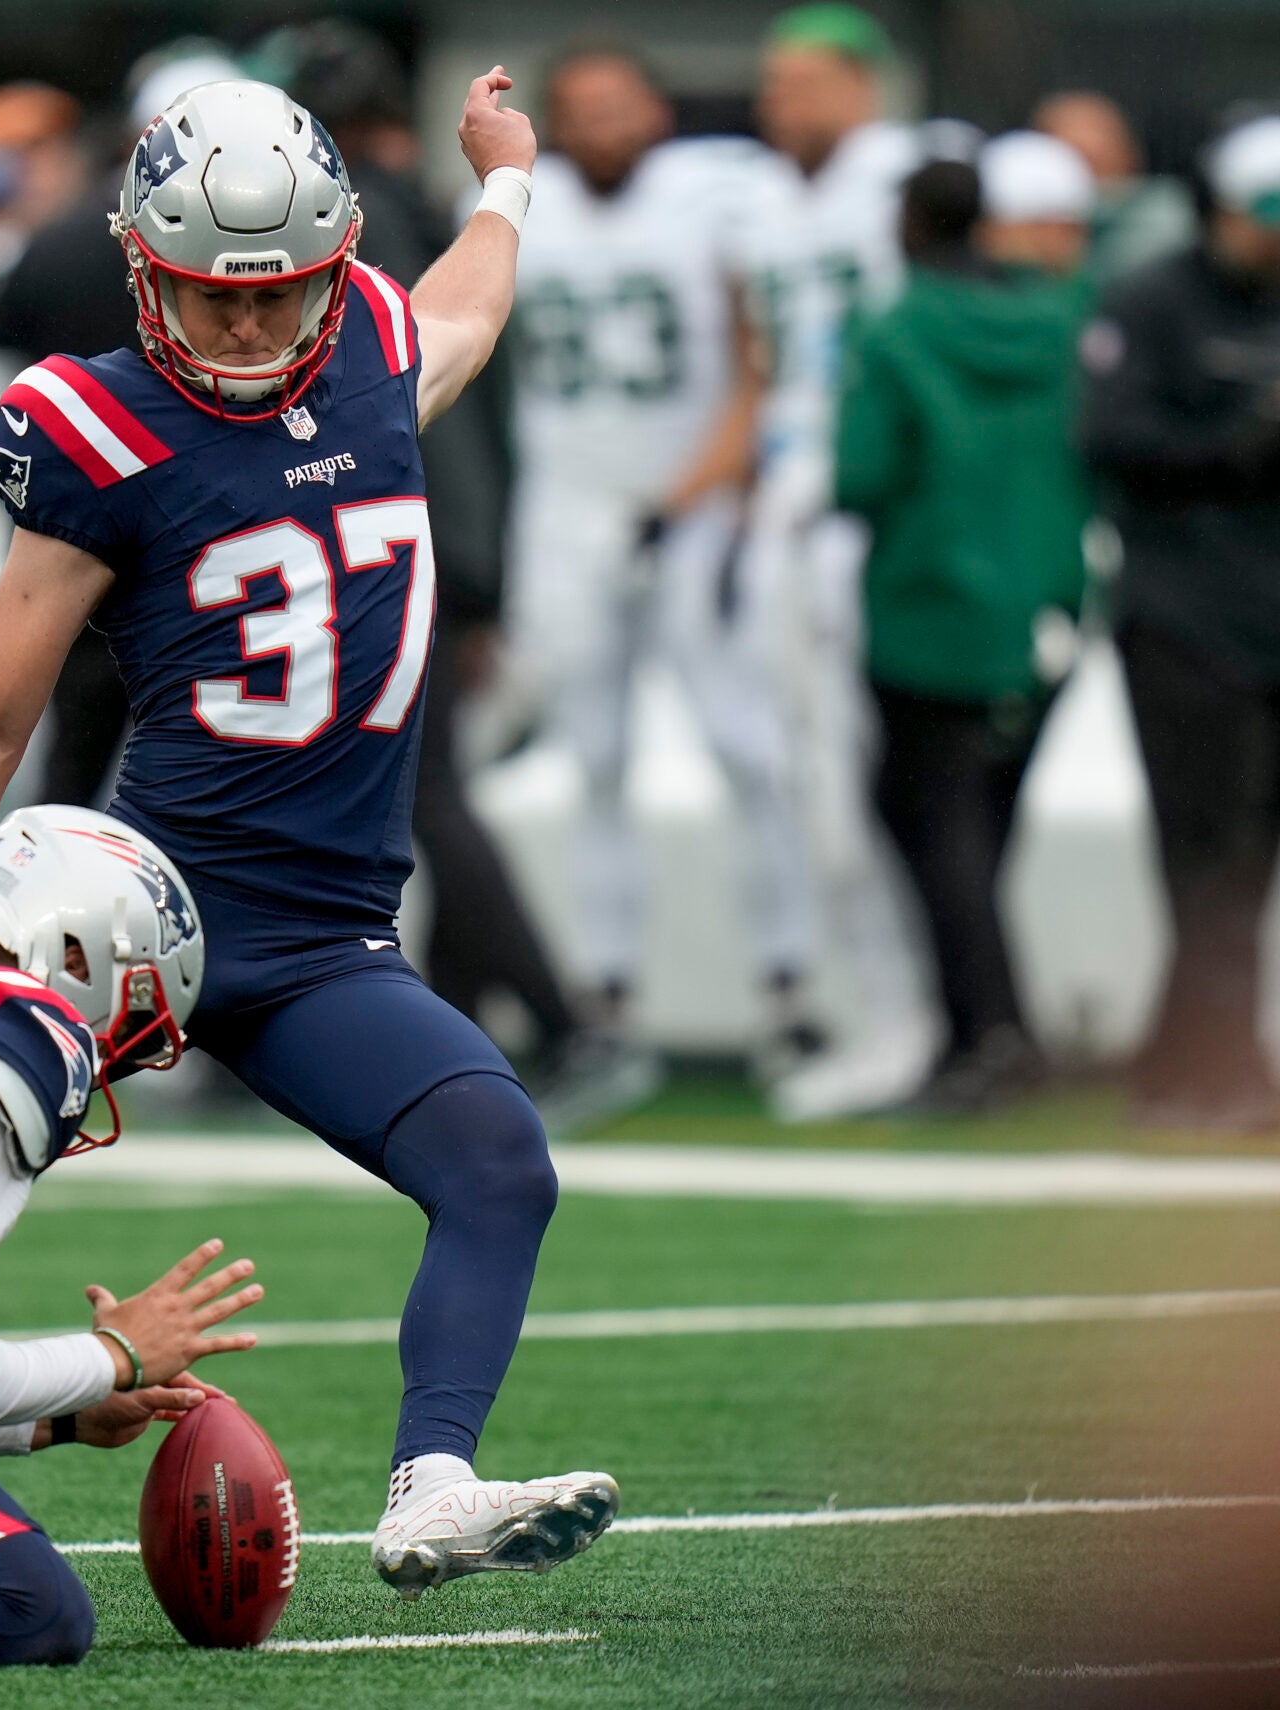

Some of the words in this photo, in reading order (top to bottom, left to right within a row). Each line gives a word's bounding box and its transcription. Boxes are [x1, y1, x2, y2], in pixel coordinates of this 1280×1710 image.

[225, 260, 283, 275] PATRIOTS
[291, 420, 312, 435] NFL
[283, 453, 356, 488] PATRIOTS
[186, 496, 437, 748] 37
[214, 1462, 228, 1516] NATIONAL
[221, 1520, 231, 1577] FOOTBALL
